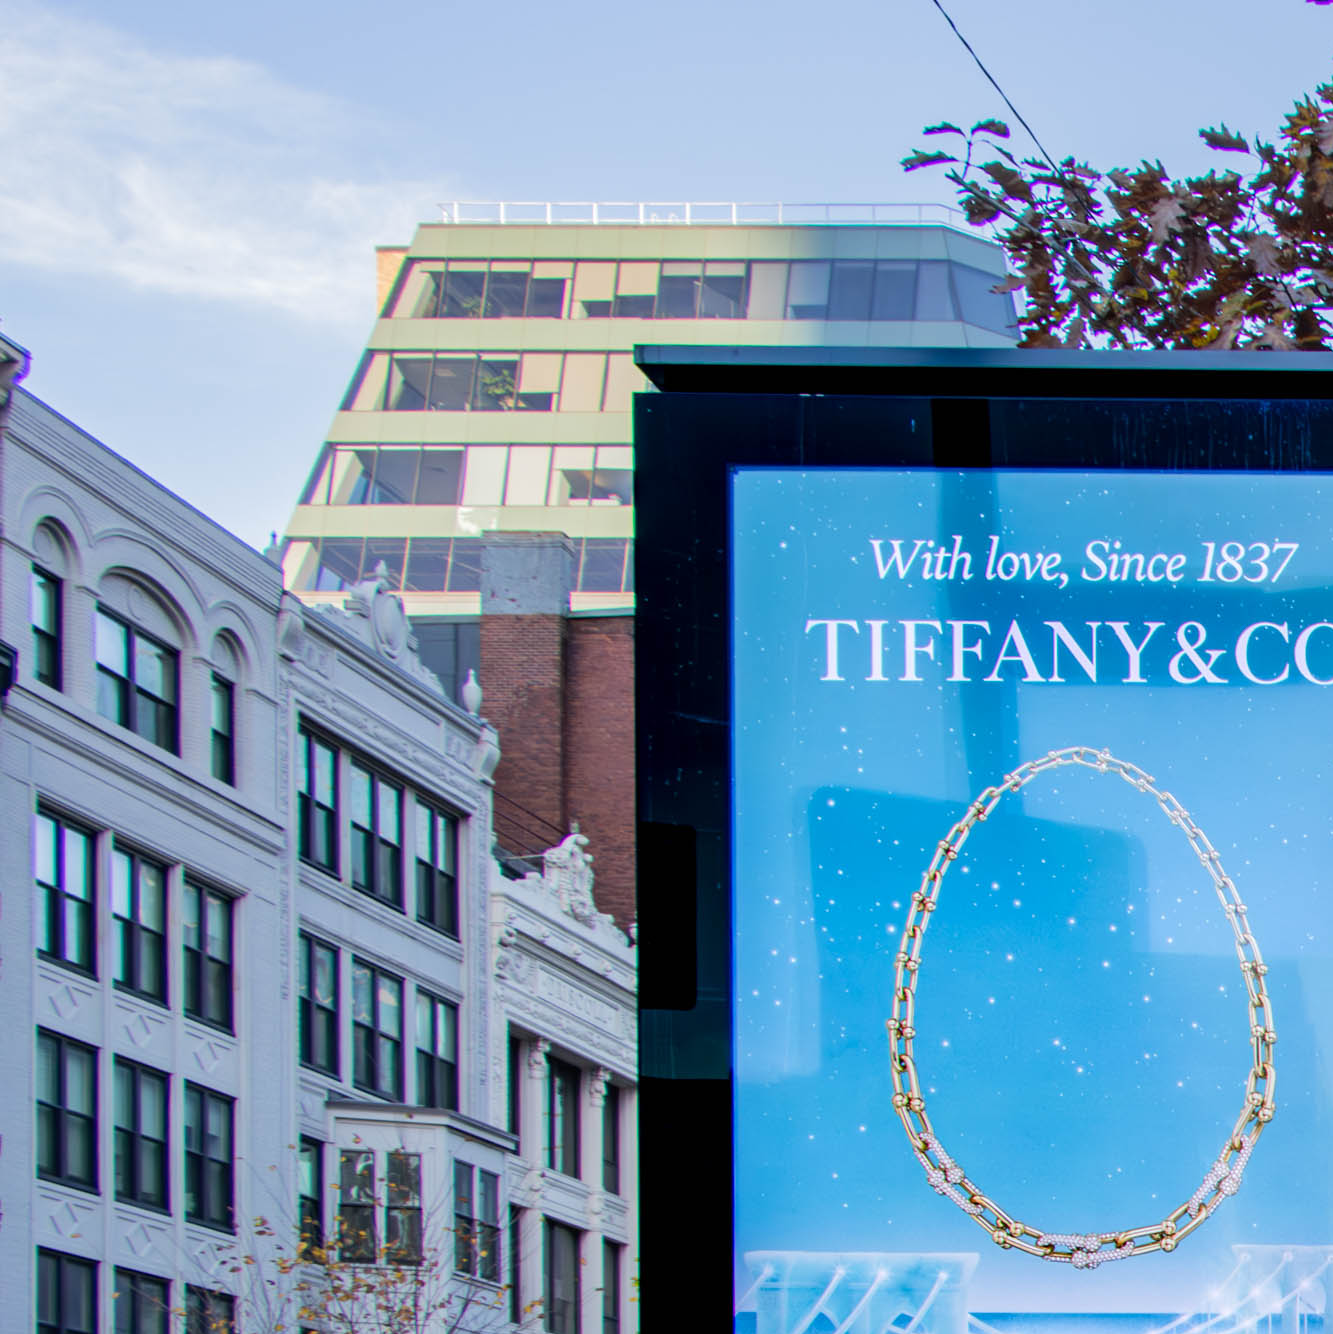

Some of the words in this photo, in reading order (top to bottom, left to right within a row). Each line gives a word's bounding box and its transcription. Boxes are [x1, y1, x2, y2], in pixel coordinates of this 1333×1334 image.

[870, 534, 972, 581] With
[986, 534, 1070, 588] love,
[1081, 537, 1187, 582] Since
[1197, 541, 1300, 584] 1837
